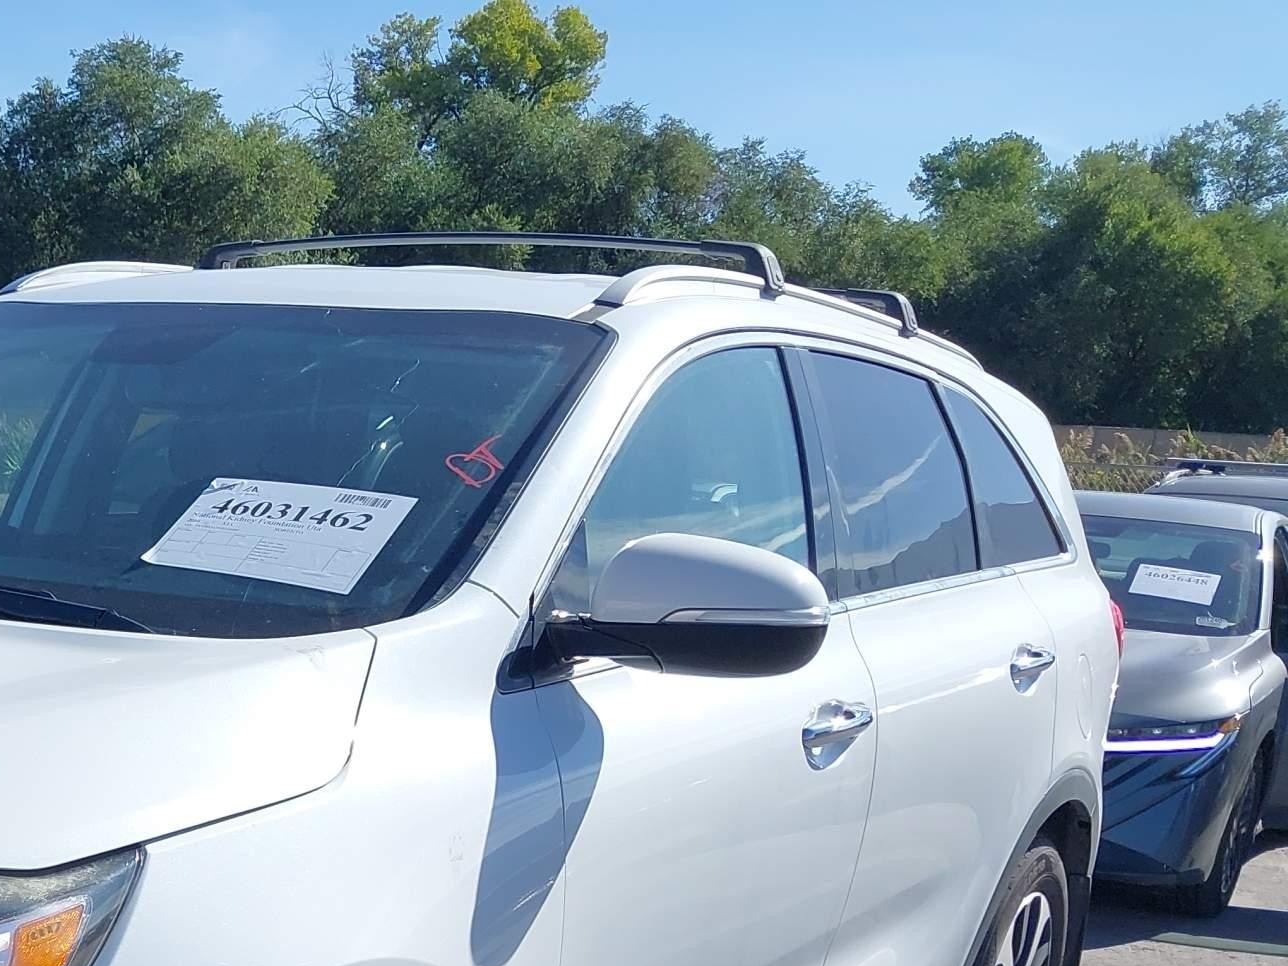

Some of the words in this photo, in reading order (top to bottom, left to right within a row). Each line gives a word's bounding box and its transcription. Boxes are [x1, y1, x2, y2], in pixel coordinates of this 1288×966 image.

[194, 512, 226, 521] National
[226, 514, 258, 524] Kidney
[258, 518, 305, 529] Foundation
[211, 498, 373, 531] 46031462
[1144, 571, 1208, 586] 46026448
